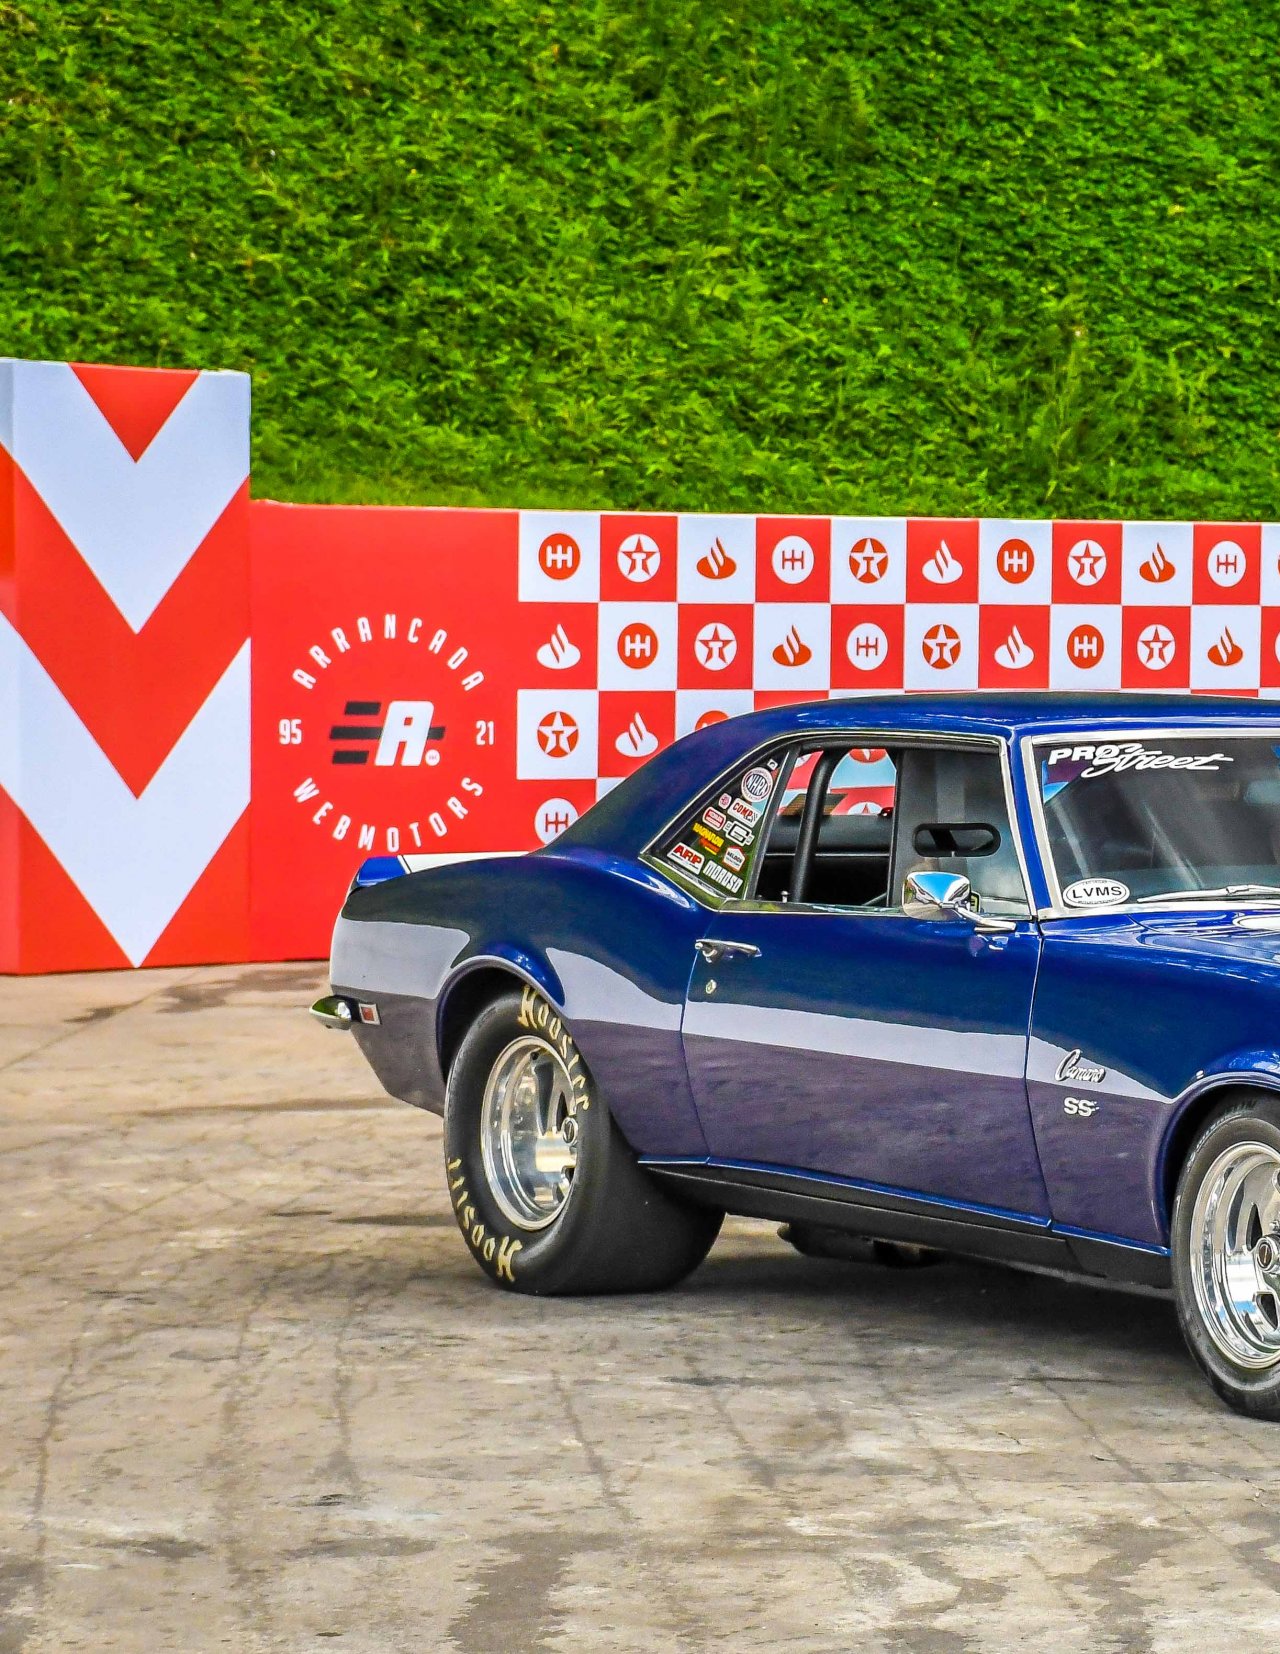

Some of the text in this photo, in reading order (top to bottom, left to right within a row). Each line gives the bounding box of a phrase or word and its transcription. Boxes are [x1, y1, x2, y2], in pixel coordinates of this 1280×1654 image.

[292, 614, 485, 691] ARRANCADA
[278, 718, 302, 745] 95
[475, 720, 495, 745] 21
[1048, 743, 1234, 778] PRO Street
[746, 773, 769, 796] NHRA
[294, 777, 484, 853] WEBMOTORS
[732, 802, 754, 819] COMP
[673, 845, 703, 865] ARP
[703, 860, 743, 893] MOROSO
[1072, 886, 1122, 899] LVMS
[1064, 1096, 1099, 1117] SS
